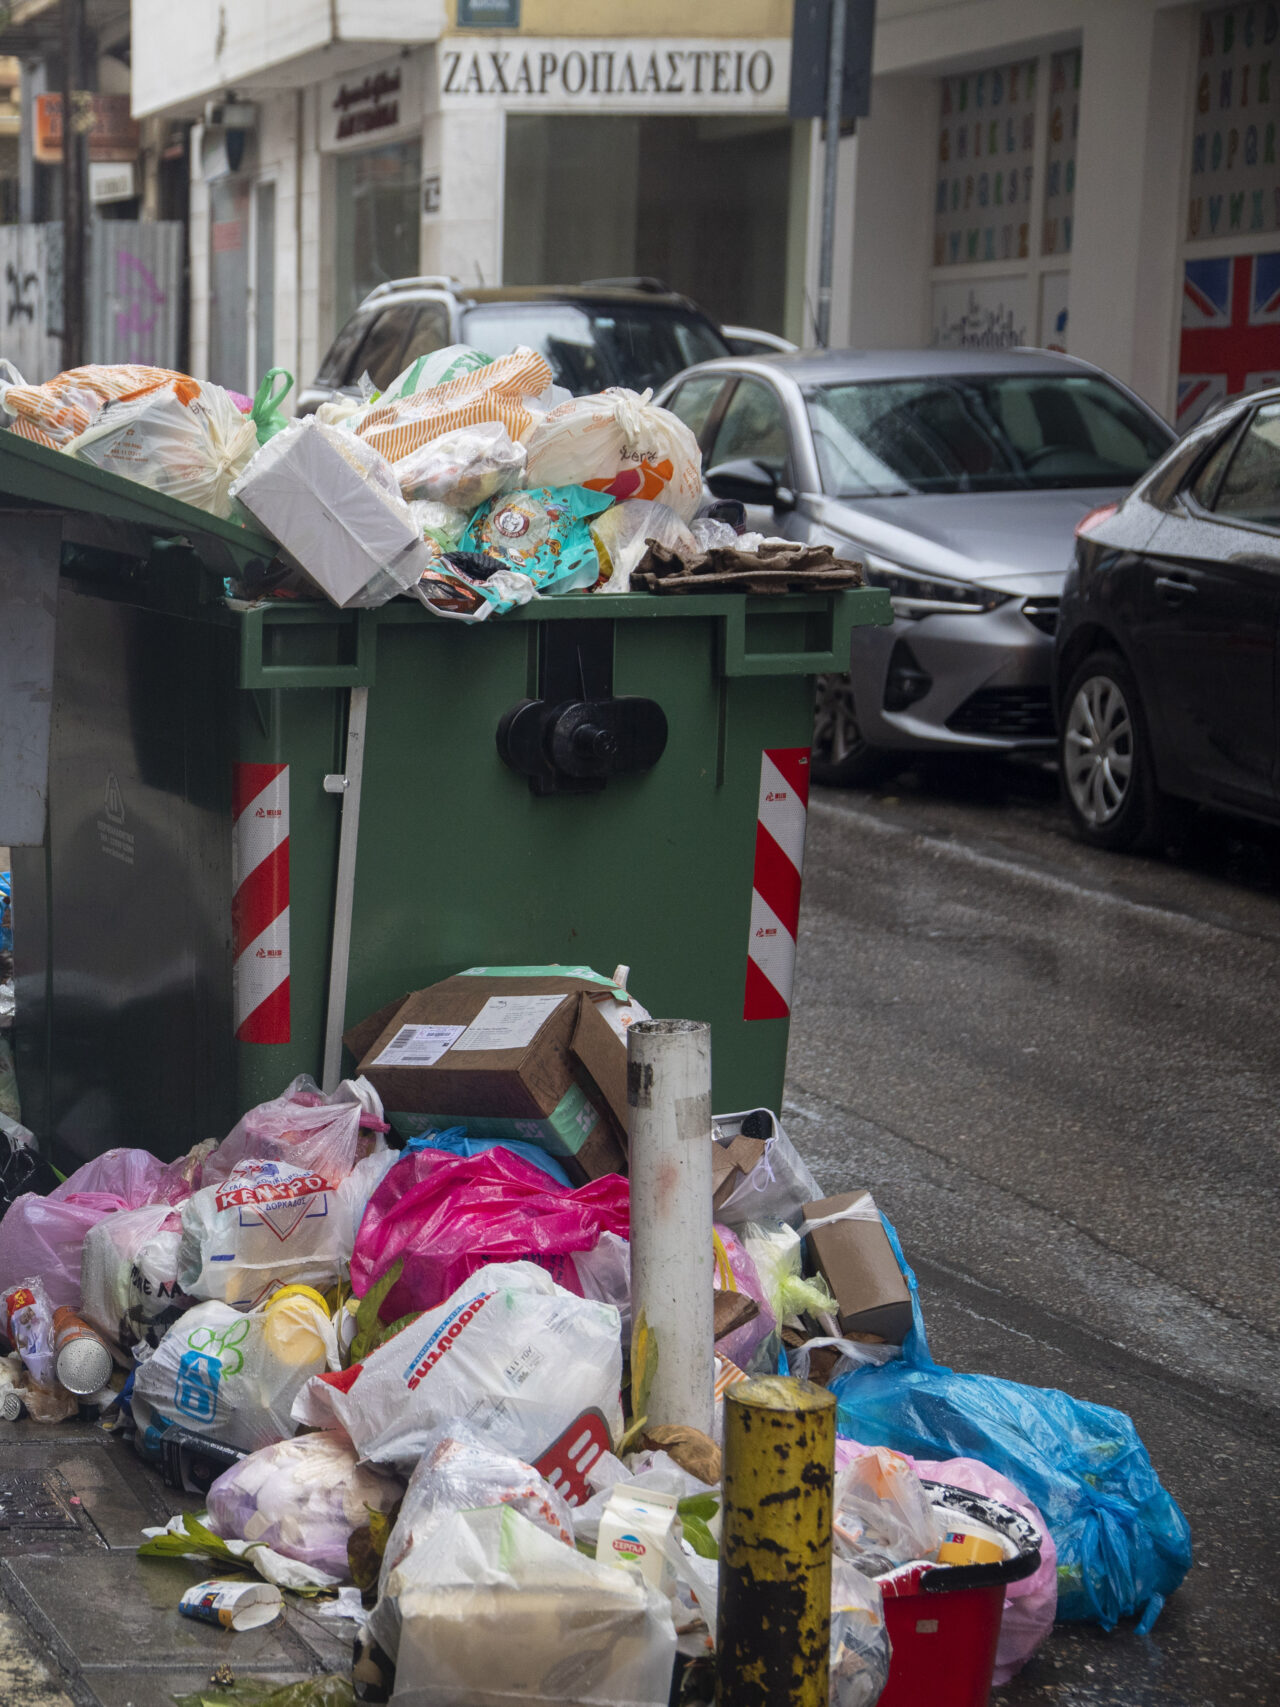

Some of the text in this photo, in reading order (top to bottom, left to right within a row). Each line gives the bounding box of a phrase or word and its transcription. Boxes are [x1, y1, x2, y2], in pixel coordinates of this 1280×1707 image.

[442, 50, 775, 94] ΖΑΧΑΡΟΠΛΑΣΤΕΙΟ
[220, 1176, 323, 1208] ΚΕΝΤΡΟ
[265, 1197, 307, 1211] ΔΟΡΚΑΔΟΣ
